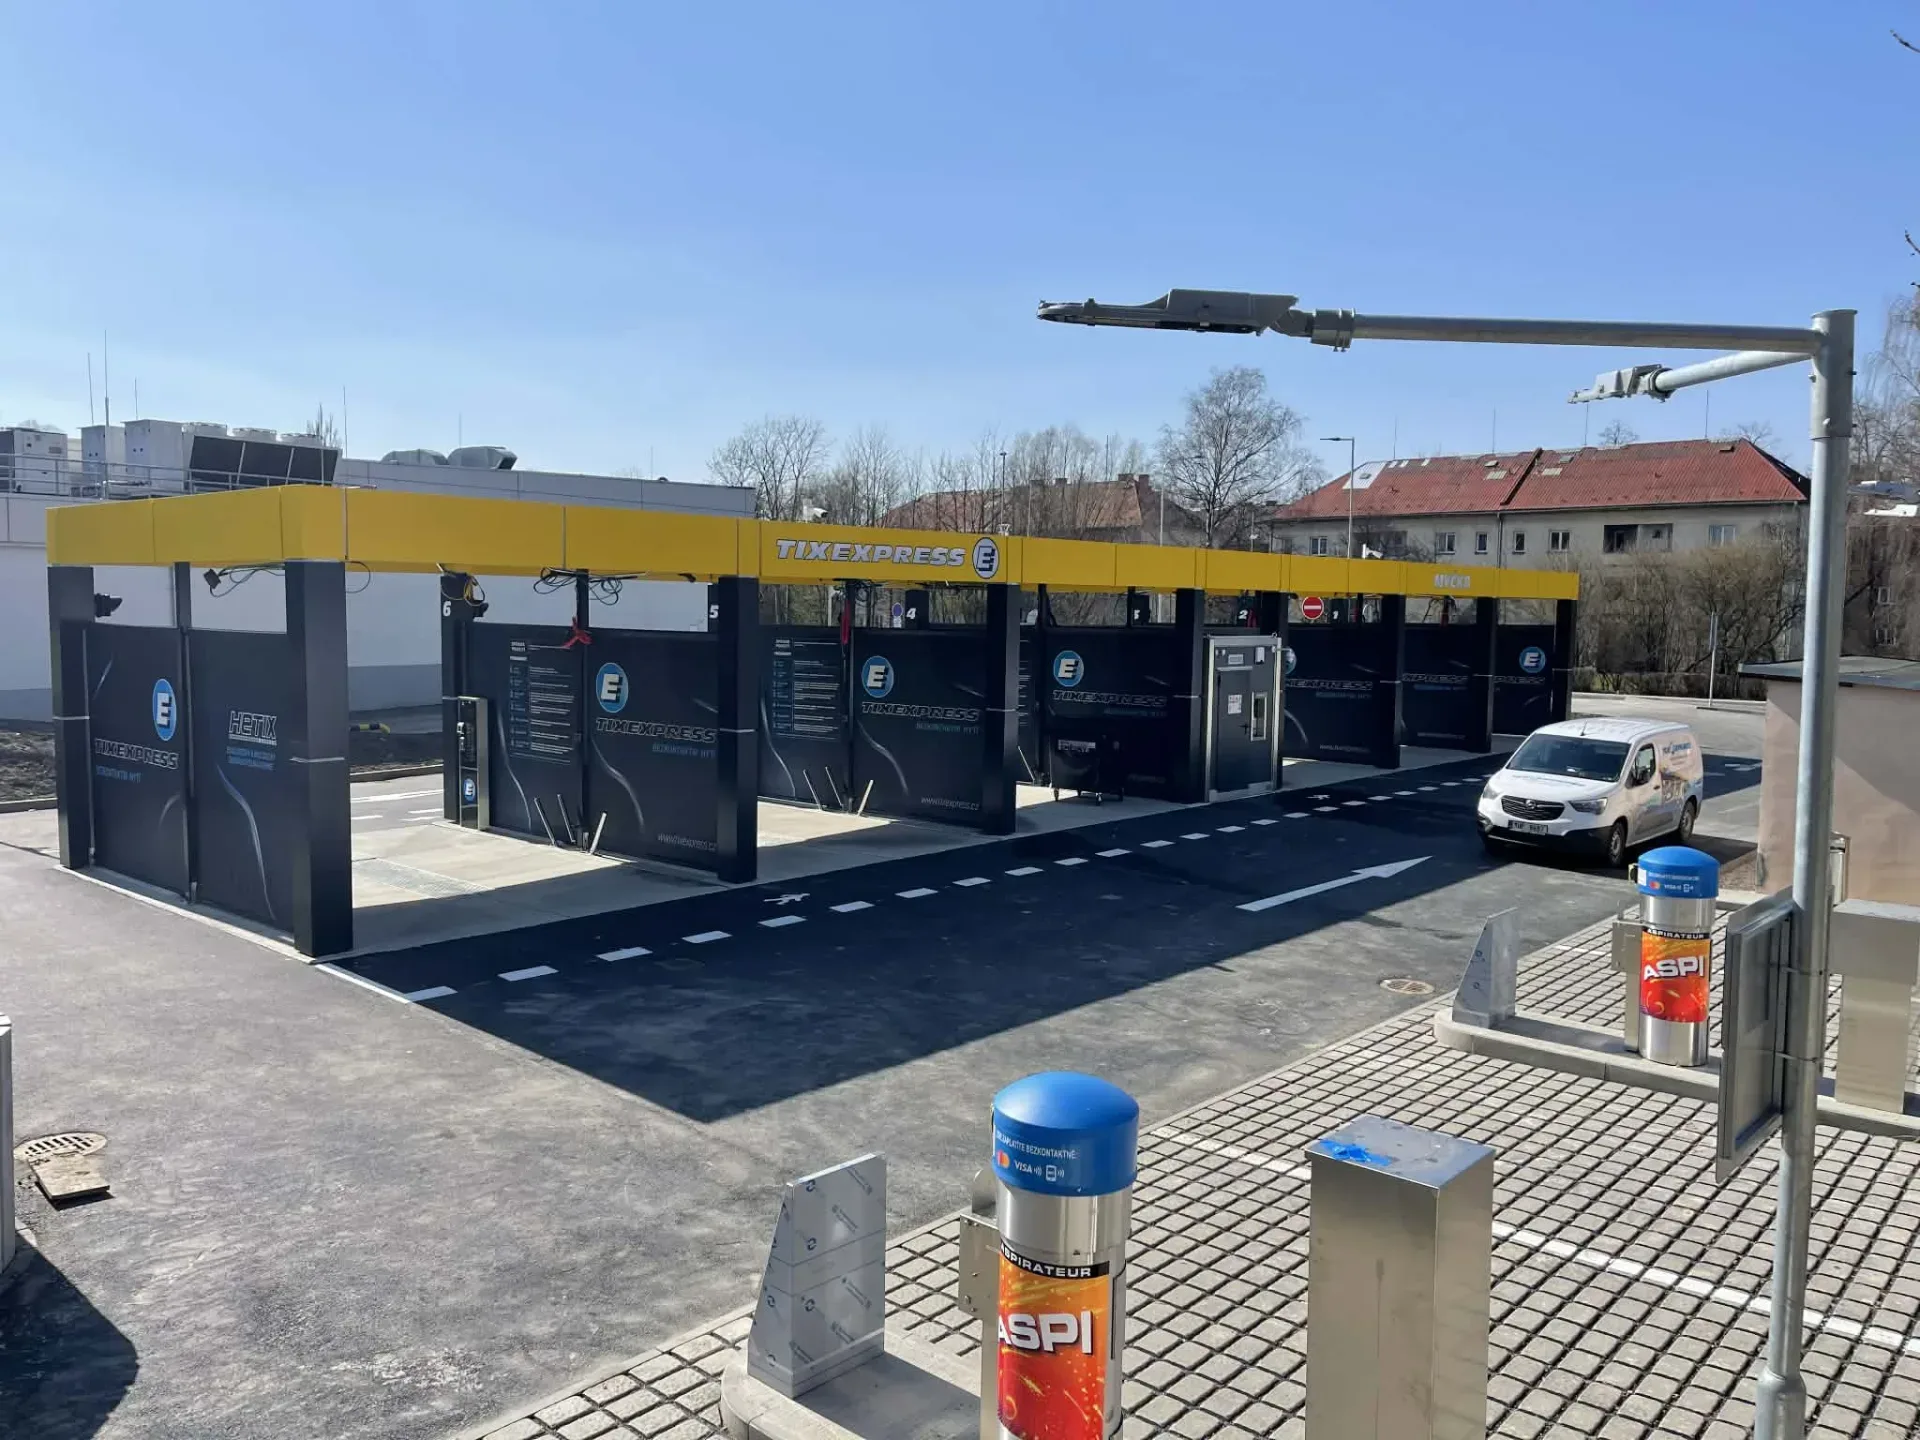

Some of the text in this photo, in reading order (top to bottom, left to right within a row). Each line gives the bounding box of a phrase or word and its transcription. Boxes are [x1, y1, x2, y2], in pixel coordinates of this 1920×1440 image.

[776, 539, 966, 566] TIXEXPRESS
[443, 601, 451, 617] 6
[709, 605, 719, 619] 5
[906, 607, 916, 619] 4
[1238, 609, 1249, 619] 2
[1333, 611, 1339, 620] 1
[1053, 689, 1168, 707] TIXEXPRESS
[861, 701, 980, 722] TIXEXPRESS
[596, 717, 716, 743] TIXEXPRESS
[95, 738, 179, 770] TIXEXPRESS
[1647, 928, 1704, 939] ASPIRATEUR
[1644, 956, 1704, 981] ASPI
[1014, 1160, 1033, 1174] VISA
[1000, 1242, 1091, 1277] ASPIRATEUR
